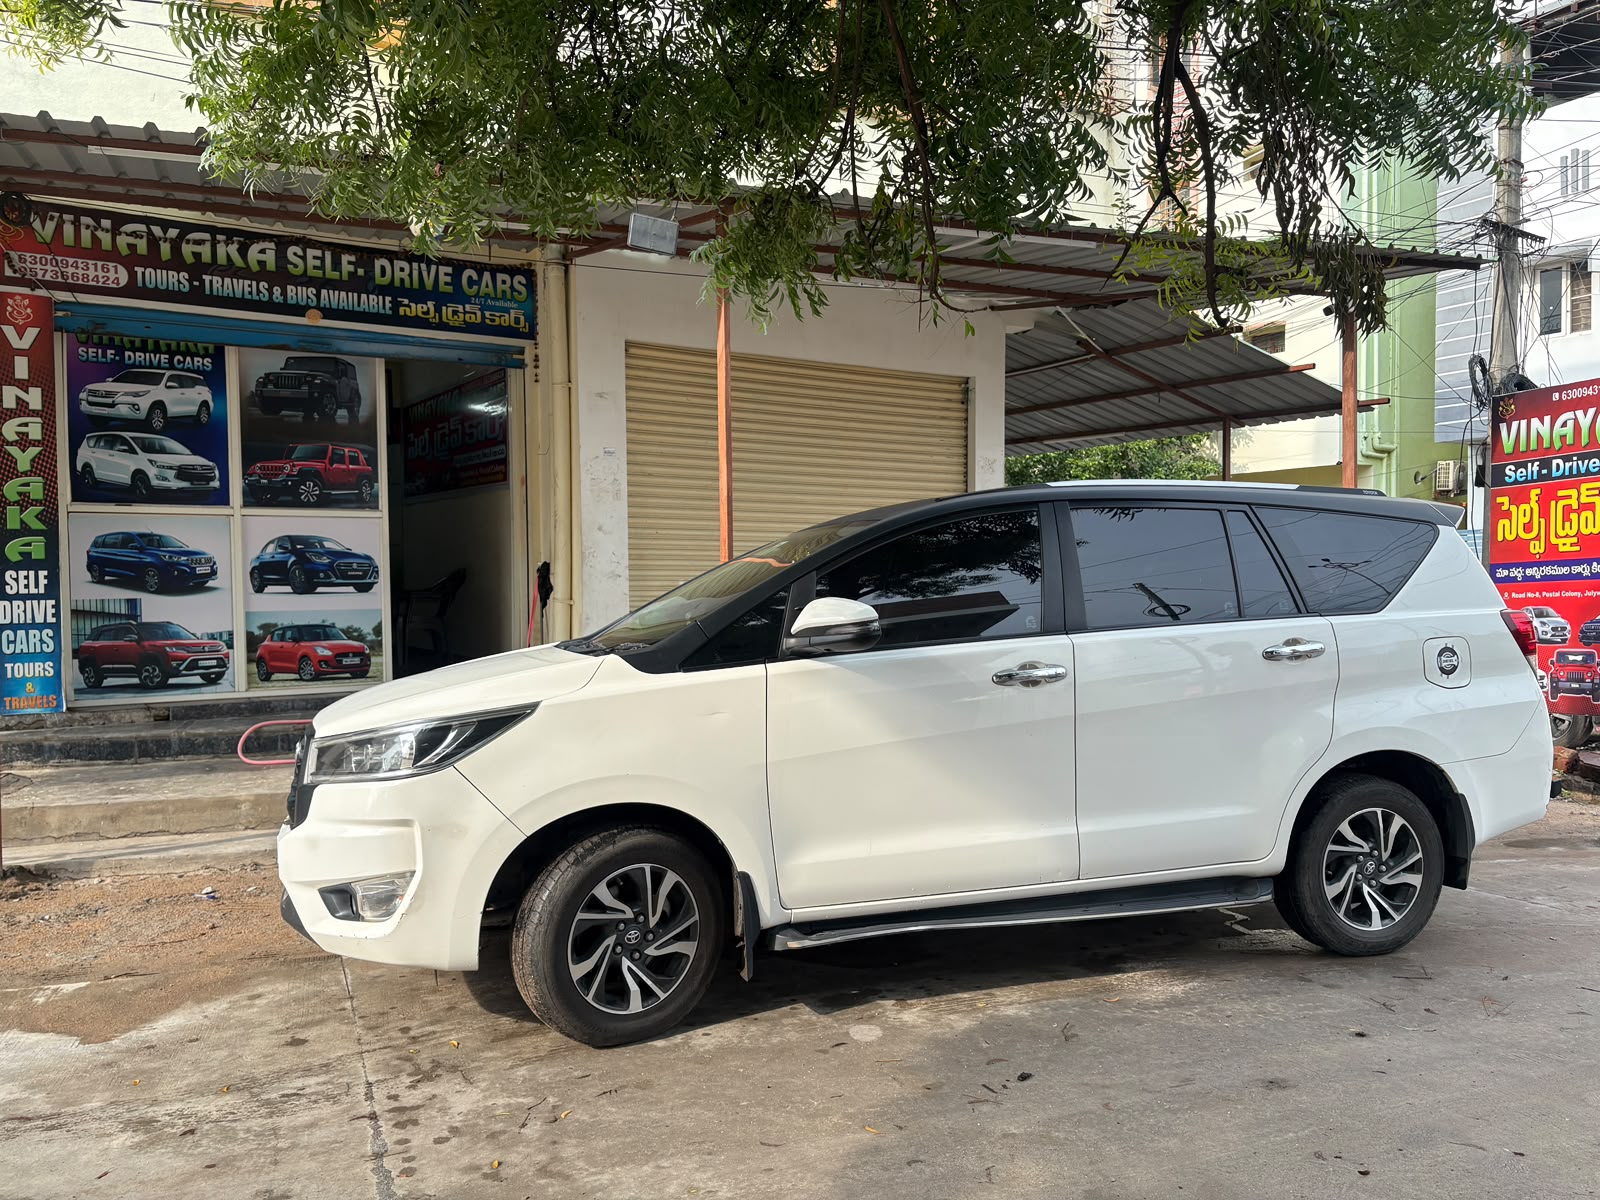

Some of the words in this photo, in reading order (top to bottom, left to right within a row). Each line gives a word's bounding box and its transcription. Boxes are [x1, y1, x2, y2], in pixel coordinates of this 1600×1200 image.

[18, 253, 120, 275] 6300943161
[30, 211, 278, 273] VINAYAKA
[286, 245, 365, 281] SELF-
[374, 257, 453, 293] DRIVE
[461, 267, 528, 302] CARS
[134, 266, 190, 293] TOURS
[202, 274, 270, 302] TRAVELS
[272, 286, 284, 304] &
[286, 285, 317, 307] BUS
[320, 290, 393, 315] AVAILABLE
[78, 347, 120, 364] SELF-
[124, 351, 170, 369] DRIVE
[173, 355, 213, 371] CARS
[1561, 385, 1600, 400] 6300943
[0, 325, 48, 563] VINAYAKA
[1499, 407, 1600, 455] VINAY
[1504, 461, 1540, 483] Self
[1551, 456, 1600, 478] Drive
[5, 570, 48, 596] SELF
[0, 599, 57, 625] DRIVE
[1, 629, 54, 655] CARS
[5, 661, 54, 680] TOURS
[25, 681, 35, 694] &
[4, 695, 57, 711] TRAVELS
